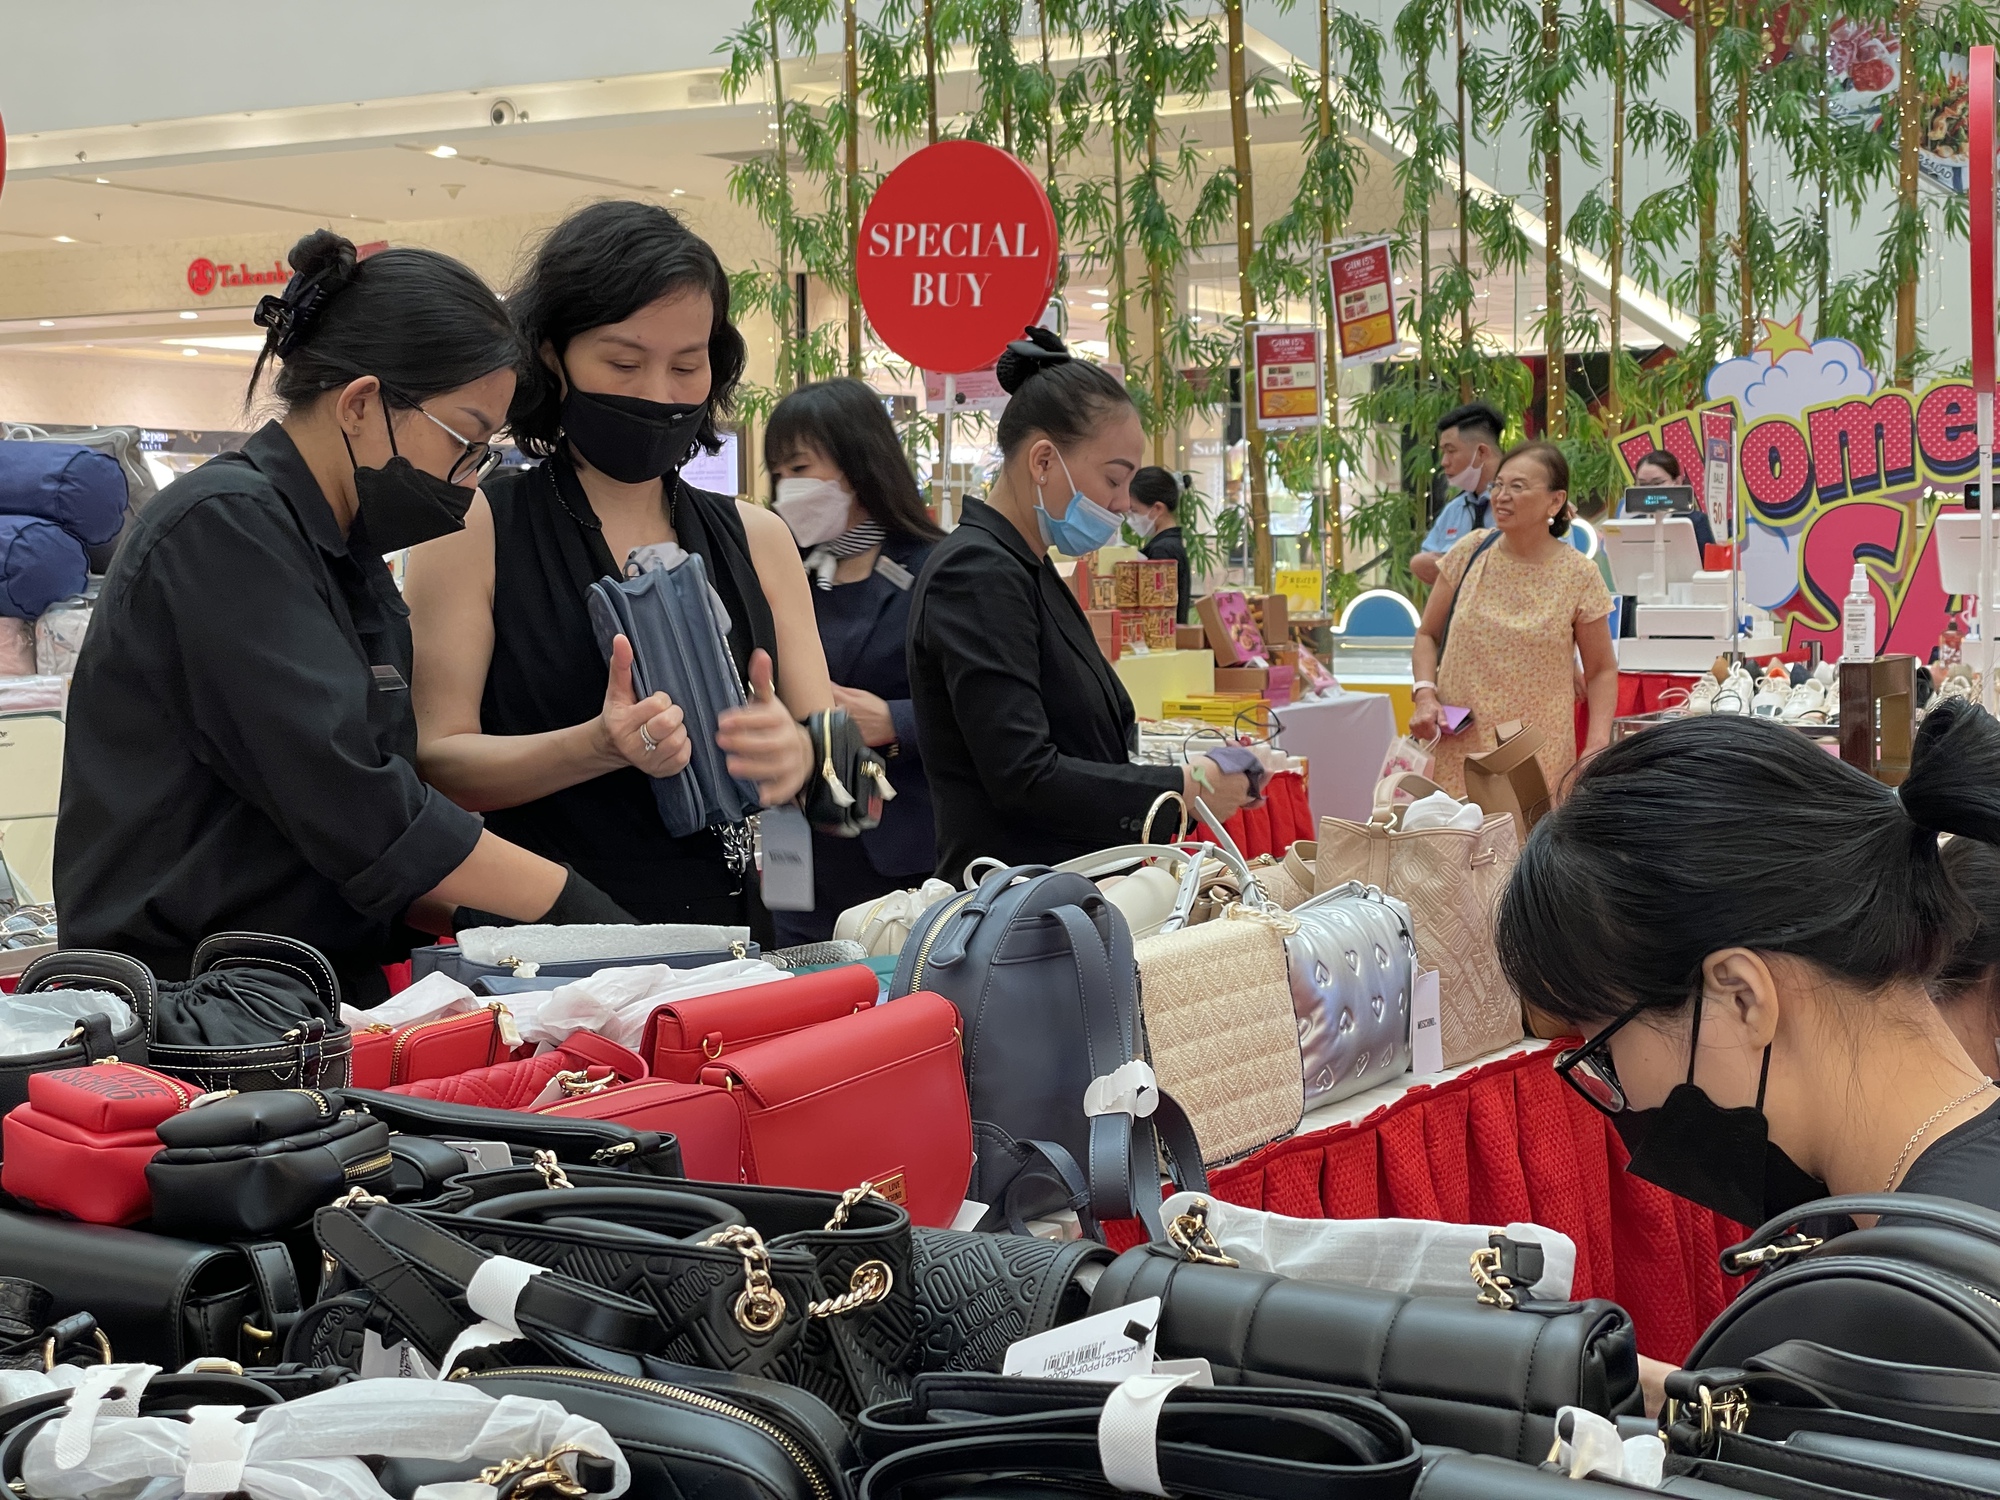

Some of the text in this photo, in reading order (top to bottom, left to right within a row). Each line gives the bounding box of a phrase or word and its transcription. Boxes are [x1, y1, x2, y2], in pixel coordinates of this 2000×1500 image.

[868, 222, 1040, 258] SPECIAL
[911, 272, 992, 307] BUY
[1614, 384, 2000, 540] Wome
[109, 1072, 168, 1099] LOVE
[888, 1180, 900, 1192] LOVE
[953, 1279, 1014, 1338] LOVE
[942, 1308, 1026, 1372] SCHINO
